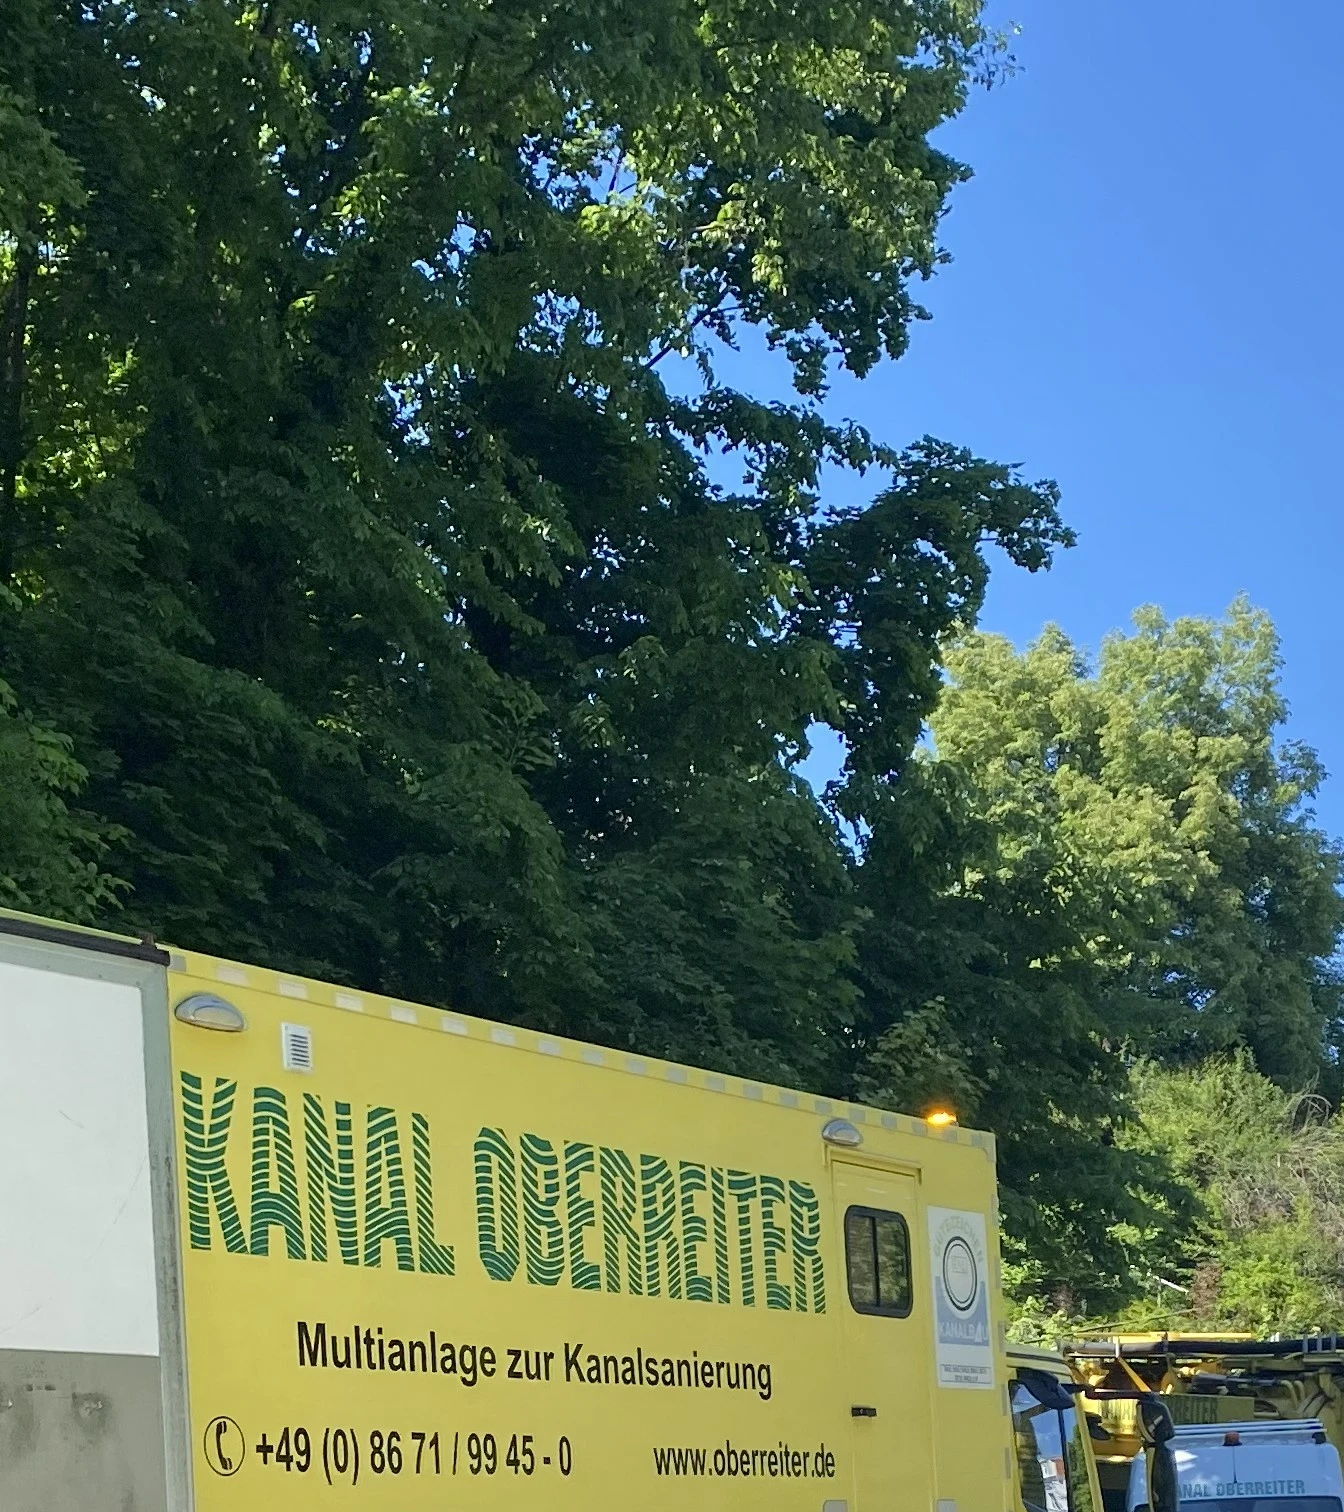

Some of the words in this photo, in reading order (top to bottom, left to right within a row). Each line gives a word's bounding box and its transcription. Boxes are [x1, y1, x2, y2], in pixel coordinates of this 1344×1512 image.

[180, 1070, 455, 1276] KANAL
[473, 1126, 827, 1315] OBERREITER
[296, 1321, 497, 1387] Multianlage
[506, 1348, 555, 1381] zur
[564, 1342, 773, 1400] Kanalsanierung
[255, 1427, 311, 1473] +49
[323, 1427, 359, 1485] (0)
[369, 1430, 403, 1475] 86
[411, 1431, 442, 1475] 71
[467, 1433, 497, 1476] 99
[653, 1439, 836, 1478] www.oberreiter.de
[1215, 1479, 1306, 1496] OBERREITER
